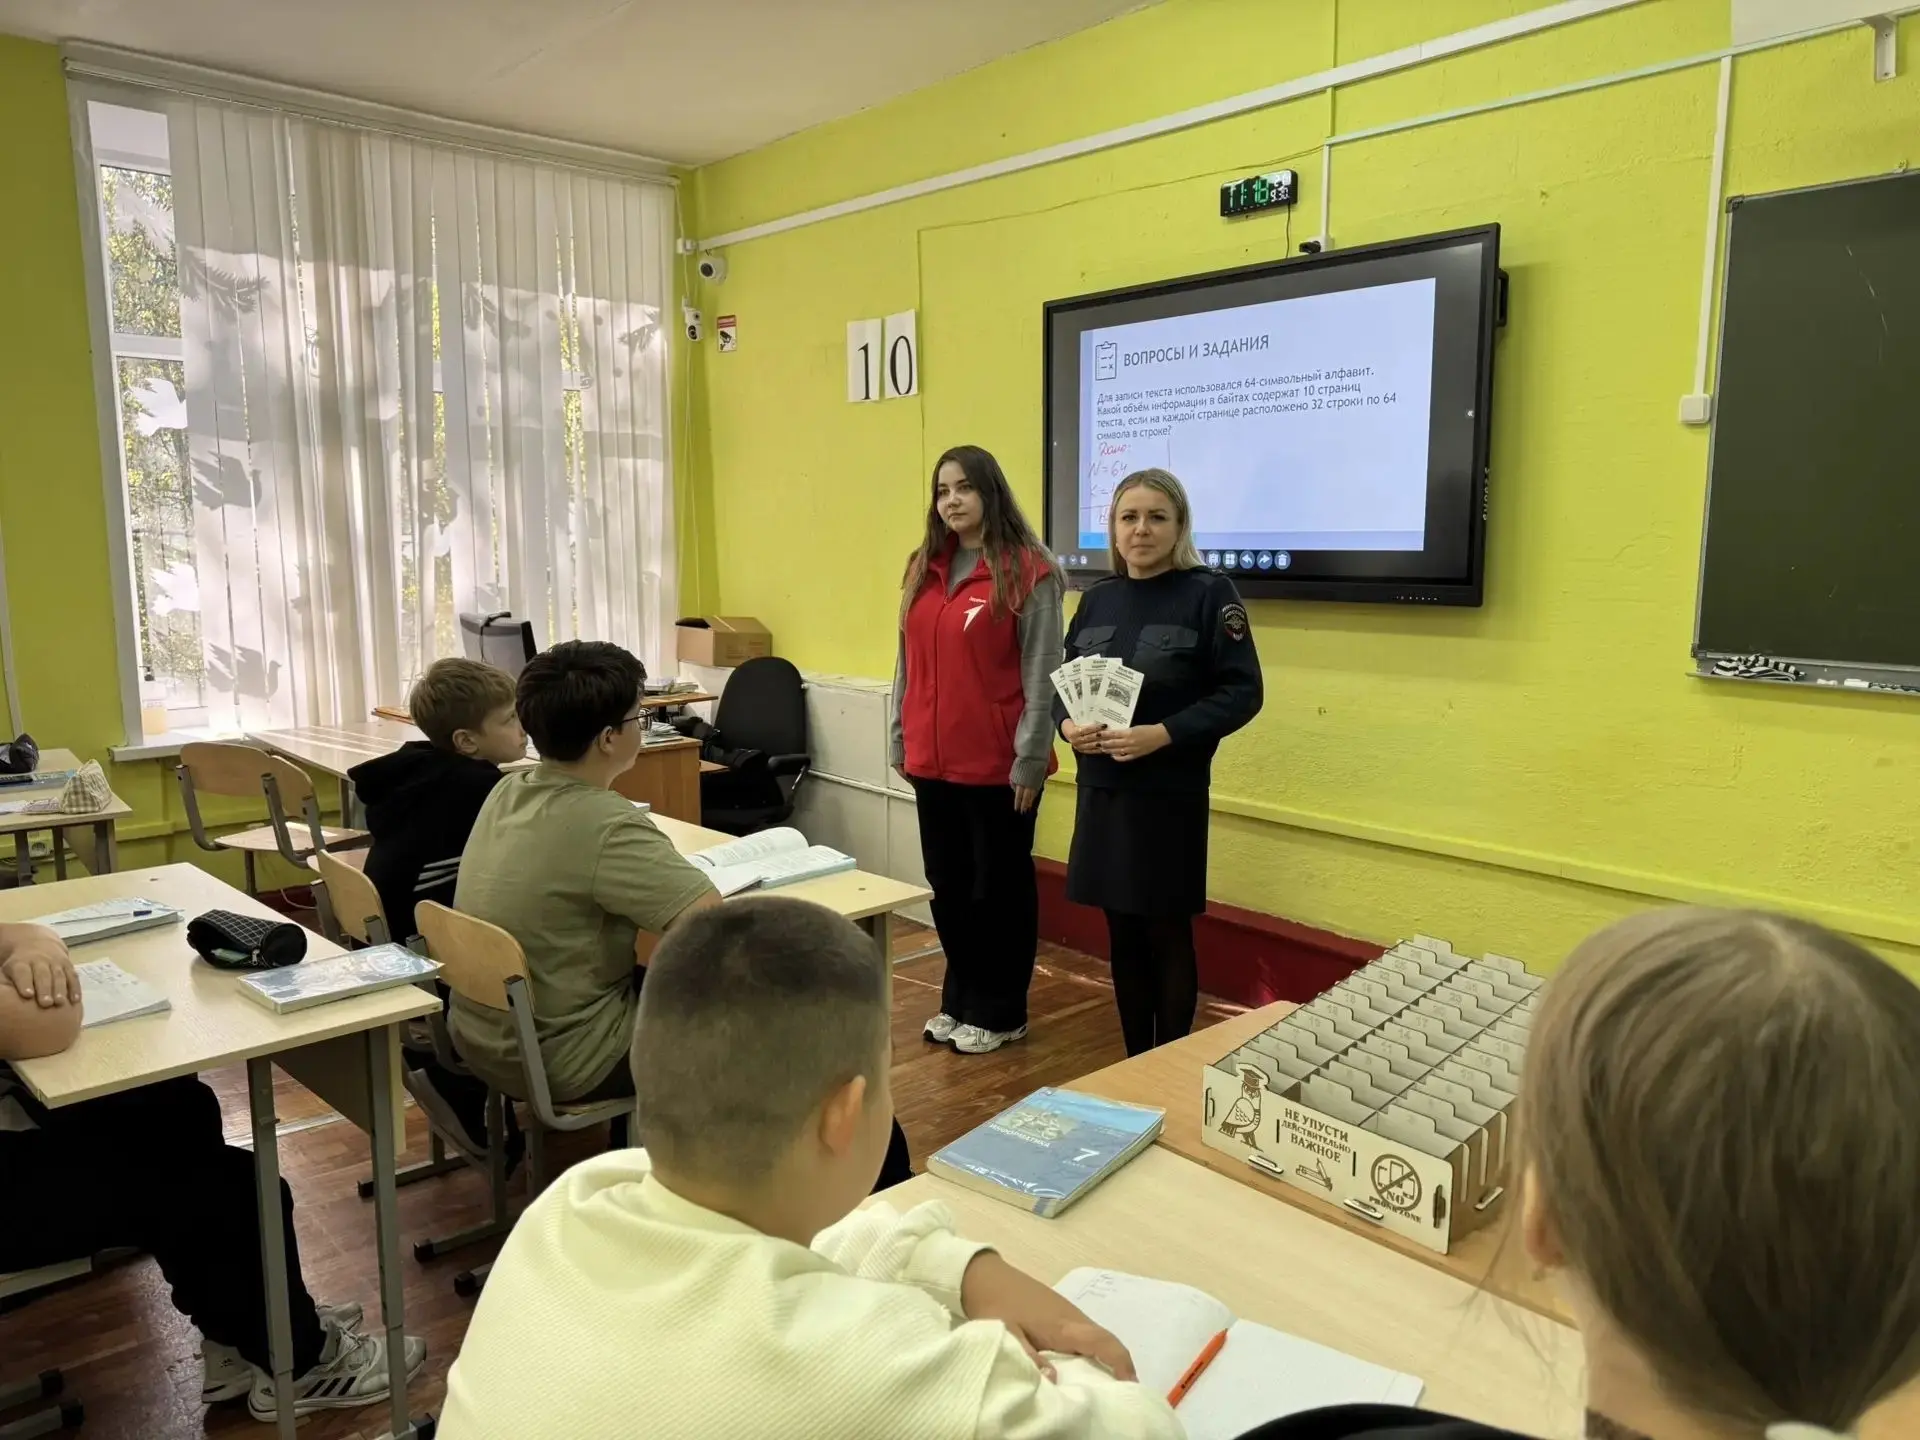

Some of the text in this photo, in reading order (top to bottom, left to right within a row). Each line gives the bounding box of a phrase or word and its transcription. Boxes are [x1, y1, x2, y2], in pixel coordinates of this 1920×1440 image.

[1123, 334, 1269, 367] ВОПРОСЫ И ЗАДАНИЯ
[857, 335, 913, 401] 10
[1097, 366, 1375, 405] Для записи текста использовался 64-символьный алфавит.
[1097, 381, 1361, 416] Какой объём информации в байтах содержат 10 страниц
[1097, 392, 1396, 429] текста, если на каждой странице расположено 32 строки по 64
[1097, 425, 1172, 441] символа в строке?
[1281, 1120, 1351, 1153] ДЕЙСТВИТЕЛЬНО
[1285, 1108, 1348, 1142] НЕ УПУСТИ
[1072, 1147, 1100, 1162] 7
[1291, 1133, 1341, 1163] ВАЖНОЕ
[1386, 1190, 1405, 1205] NO
[1399, 1209, 1421, 1224] ZONE
